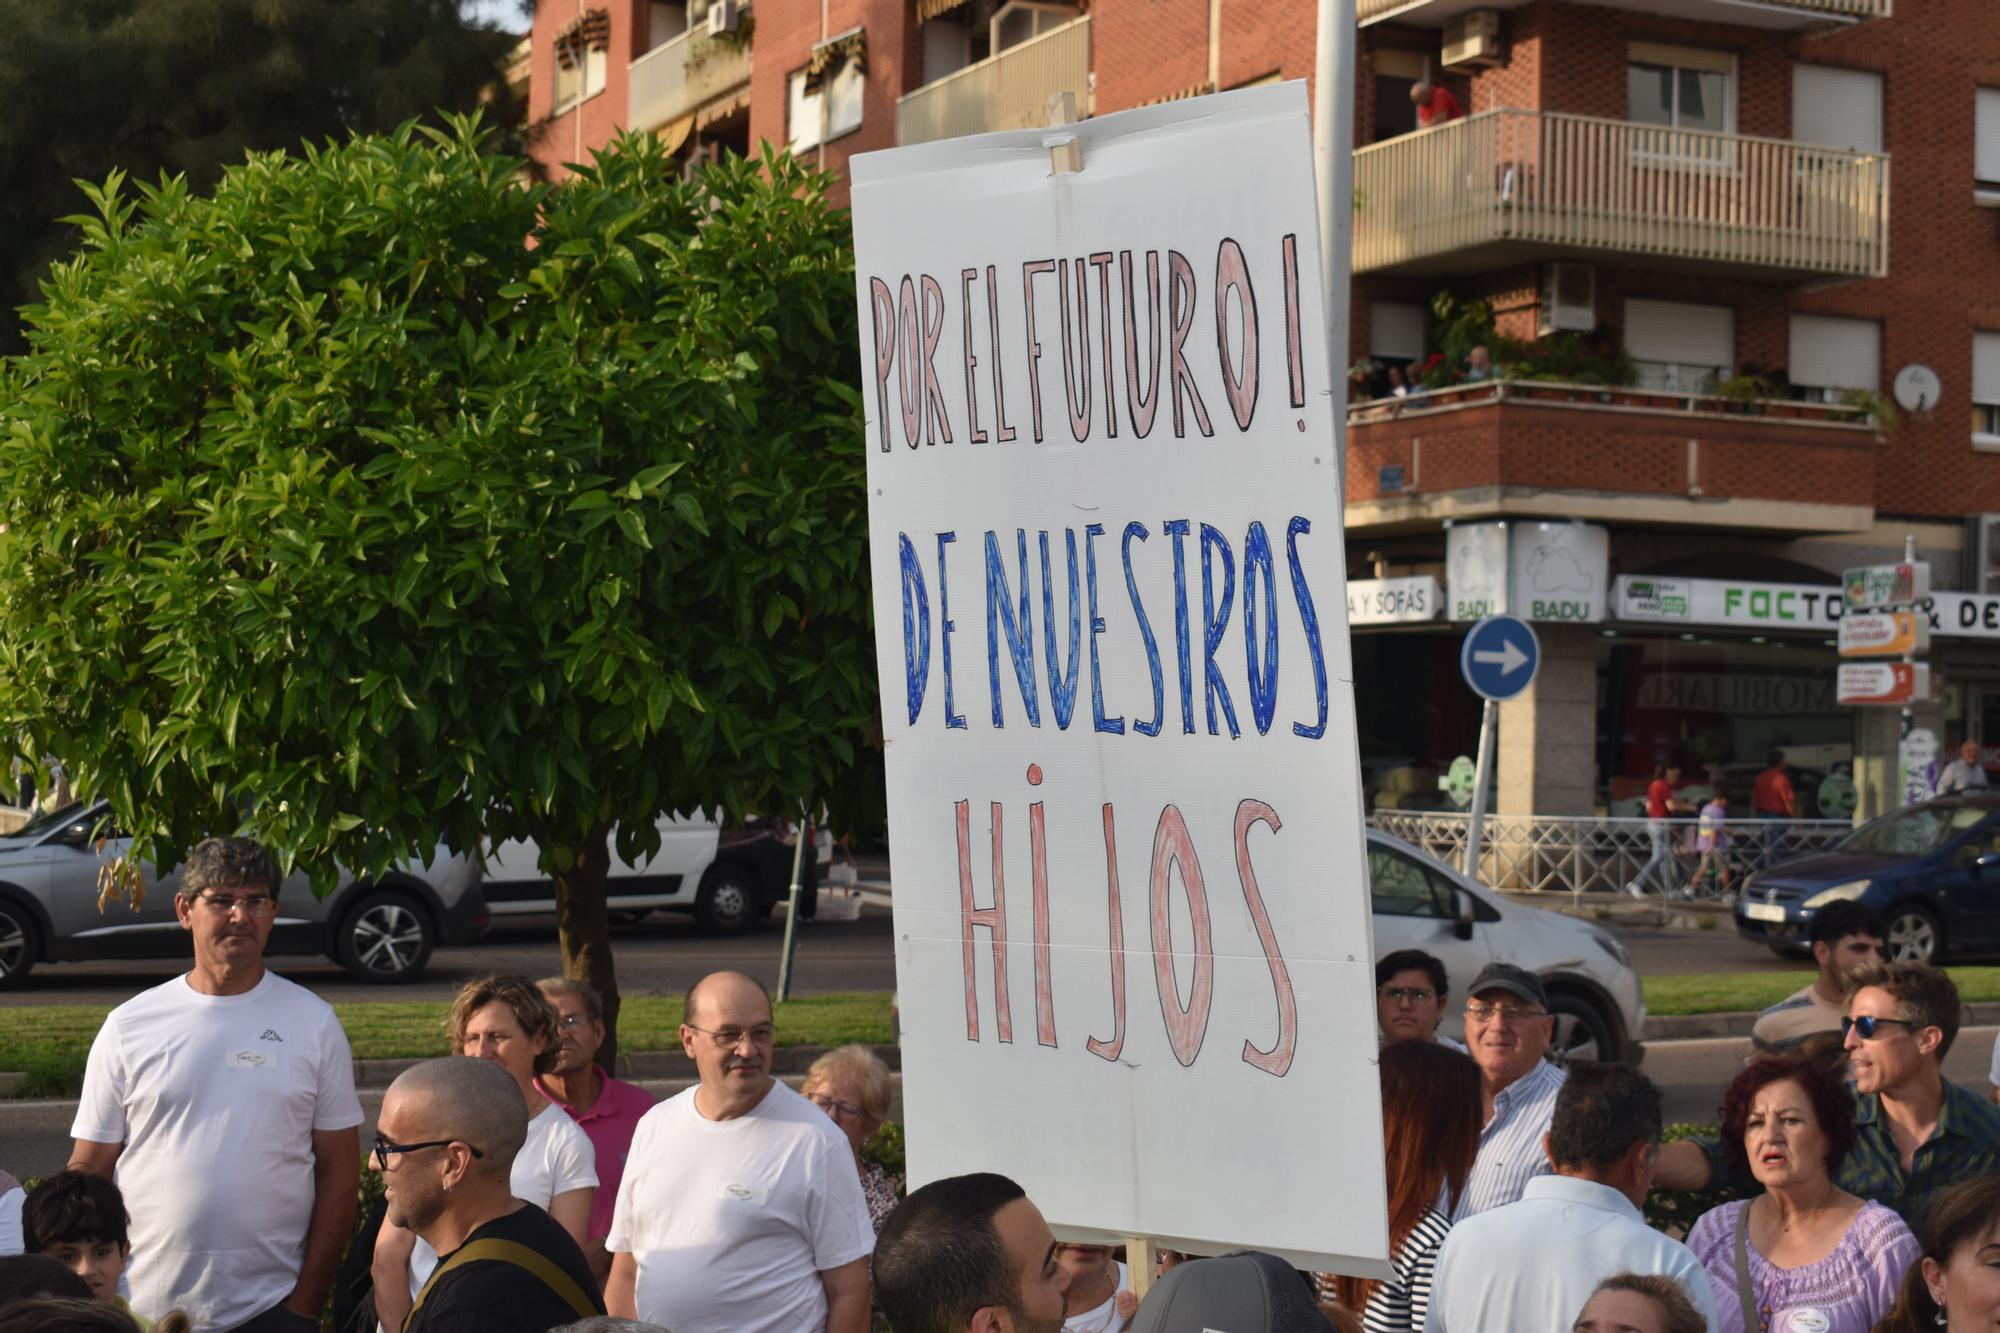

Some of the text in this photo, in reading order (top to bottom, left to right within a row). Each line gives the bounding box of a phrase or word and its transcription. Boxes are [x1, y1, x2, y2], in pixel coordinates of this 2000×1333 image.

[870, 274, 953, 452] POR
[962, 264, 1016, 445] EL
[1361, 591, 1370, 616] Y
[1376, 584, 1425, 614] SOFÁS
[1457, 600, 1494, 618] BADU
[1531, 600, 1590, 619] BADU
[1725, 589, 1898, 620] FACTO
[899, 516, 1328, 740] DE NUESTROS
